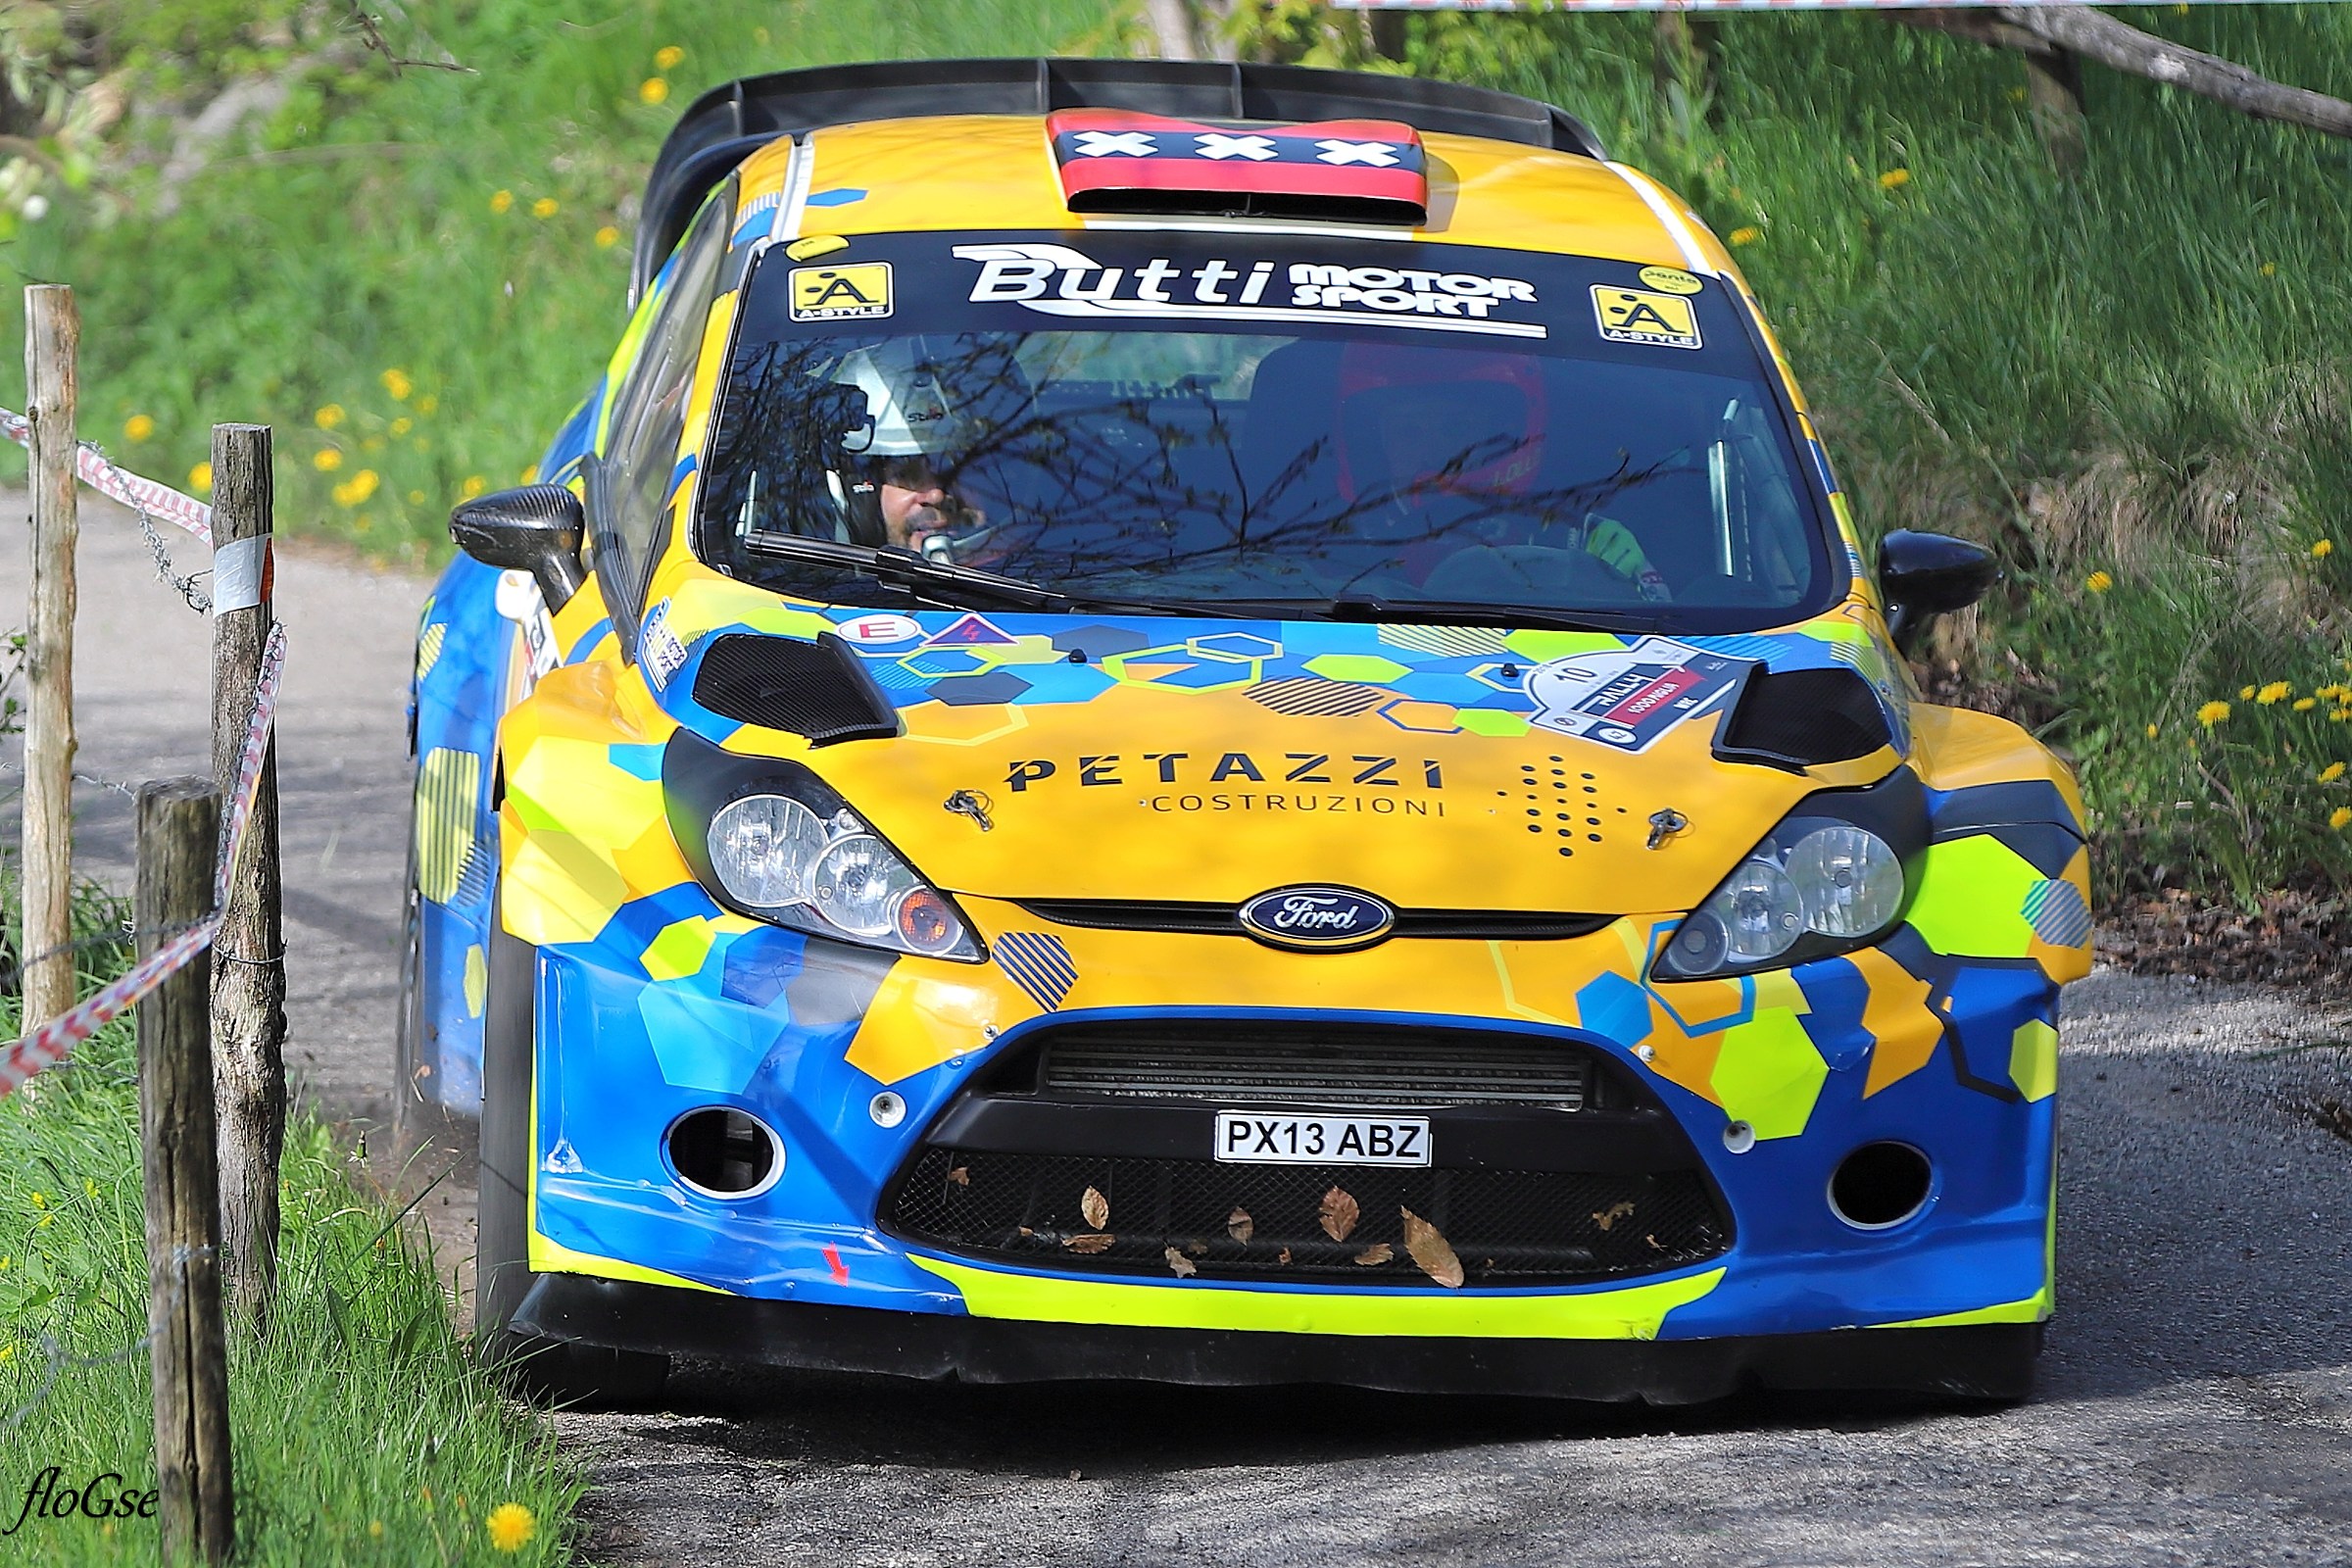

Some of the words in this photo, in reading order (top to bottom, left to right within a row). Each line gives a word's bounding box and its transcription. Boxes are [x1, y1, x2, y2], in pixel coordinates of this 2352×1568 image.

[966, 257, 1277, 305] Butti
[1288, 263, 1539, 302] MOTOR
[799, 306, 885, 318] A-STYLE
[1291, 283, 1500, 318] SPORT
[1608, 329, 1694, 346] A-STYLE
[1552, 666, 1598, 684] 10
[1003, 752, 1445, 793] PETAZZI
[1151, 793, 1446, 817] COSTRUZIONI
[1273, 896, 1359, 930] Ford
[1227, 1119, 1326, 1156] PX13
[1336, 1122, 1421, 1158] ABZ
